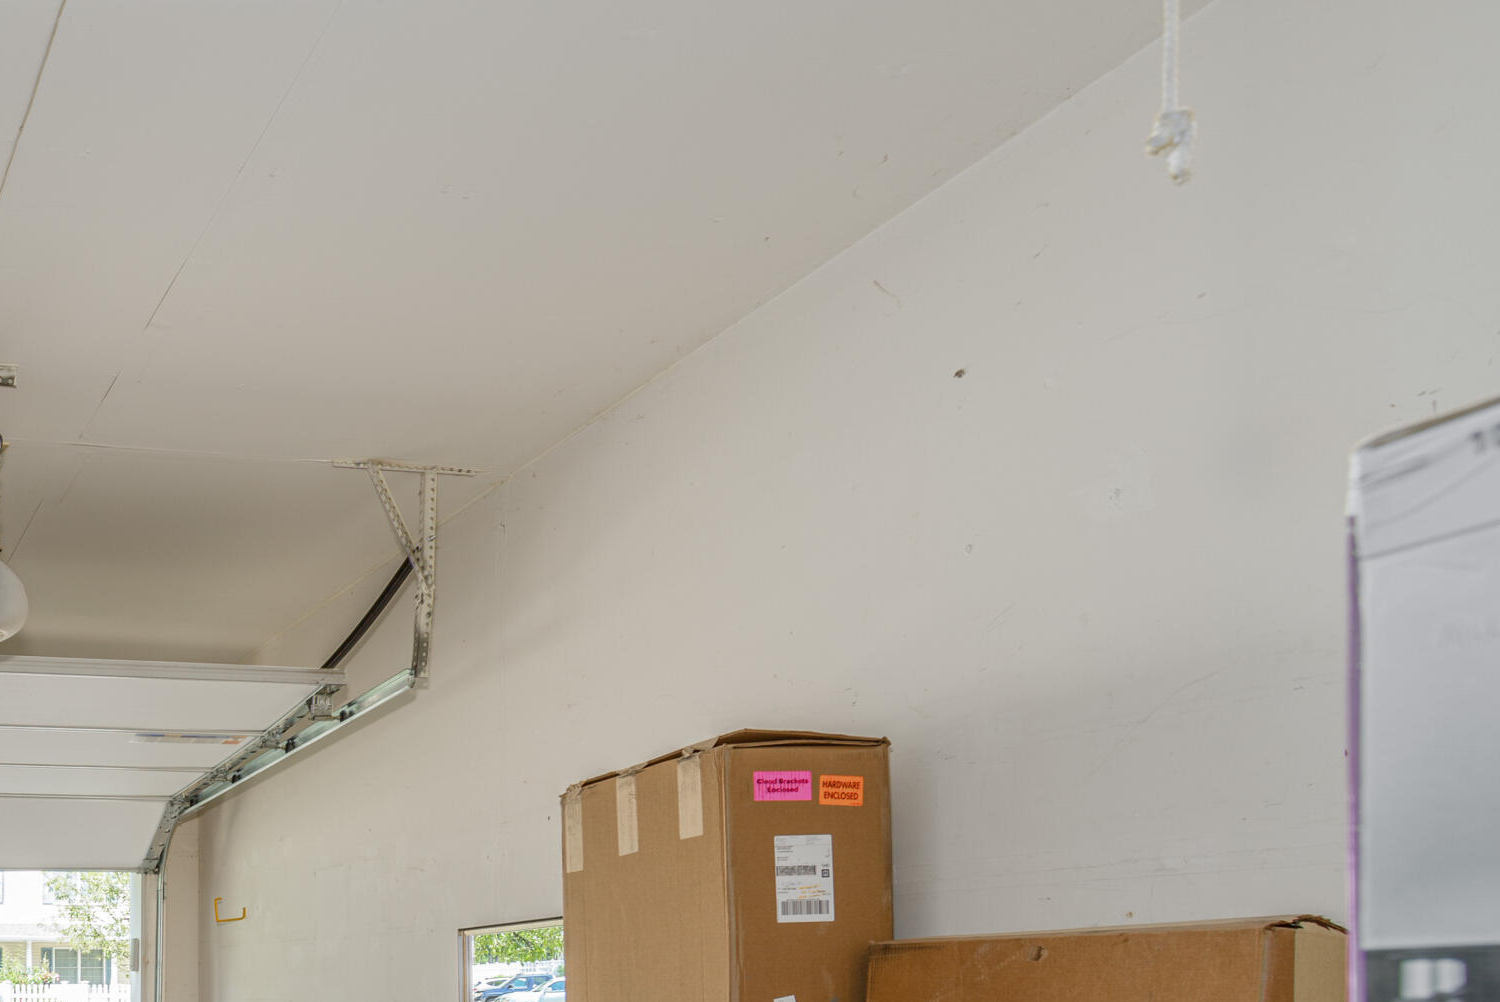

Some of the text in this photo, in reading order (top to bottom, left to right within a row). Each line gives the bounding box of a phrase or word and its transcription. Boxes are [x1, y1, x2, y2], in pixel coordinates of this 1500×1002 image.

[779, 777, 809, 785] Brackets
[822, 780, 861, 790] HARDWARE
[824, 791, 859, 800] ENCLOSED
